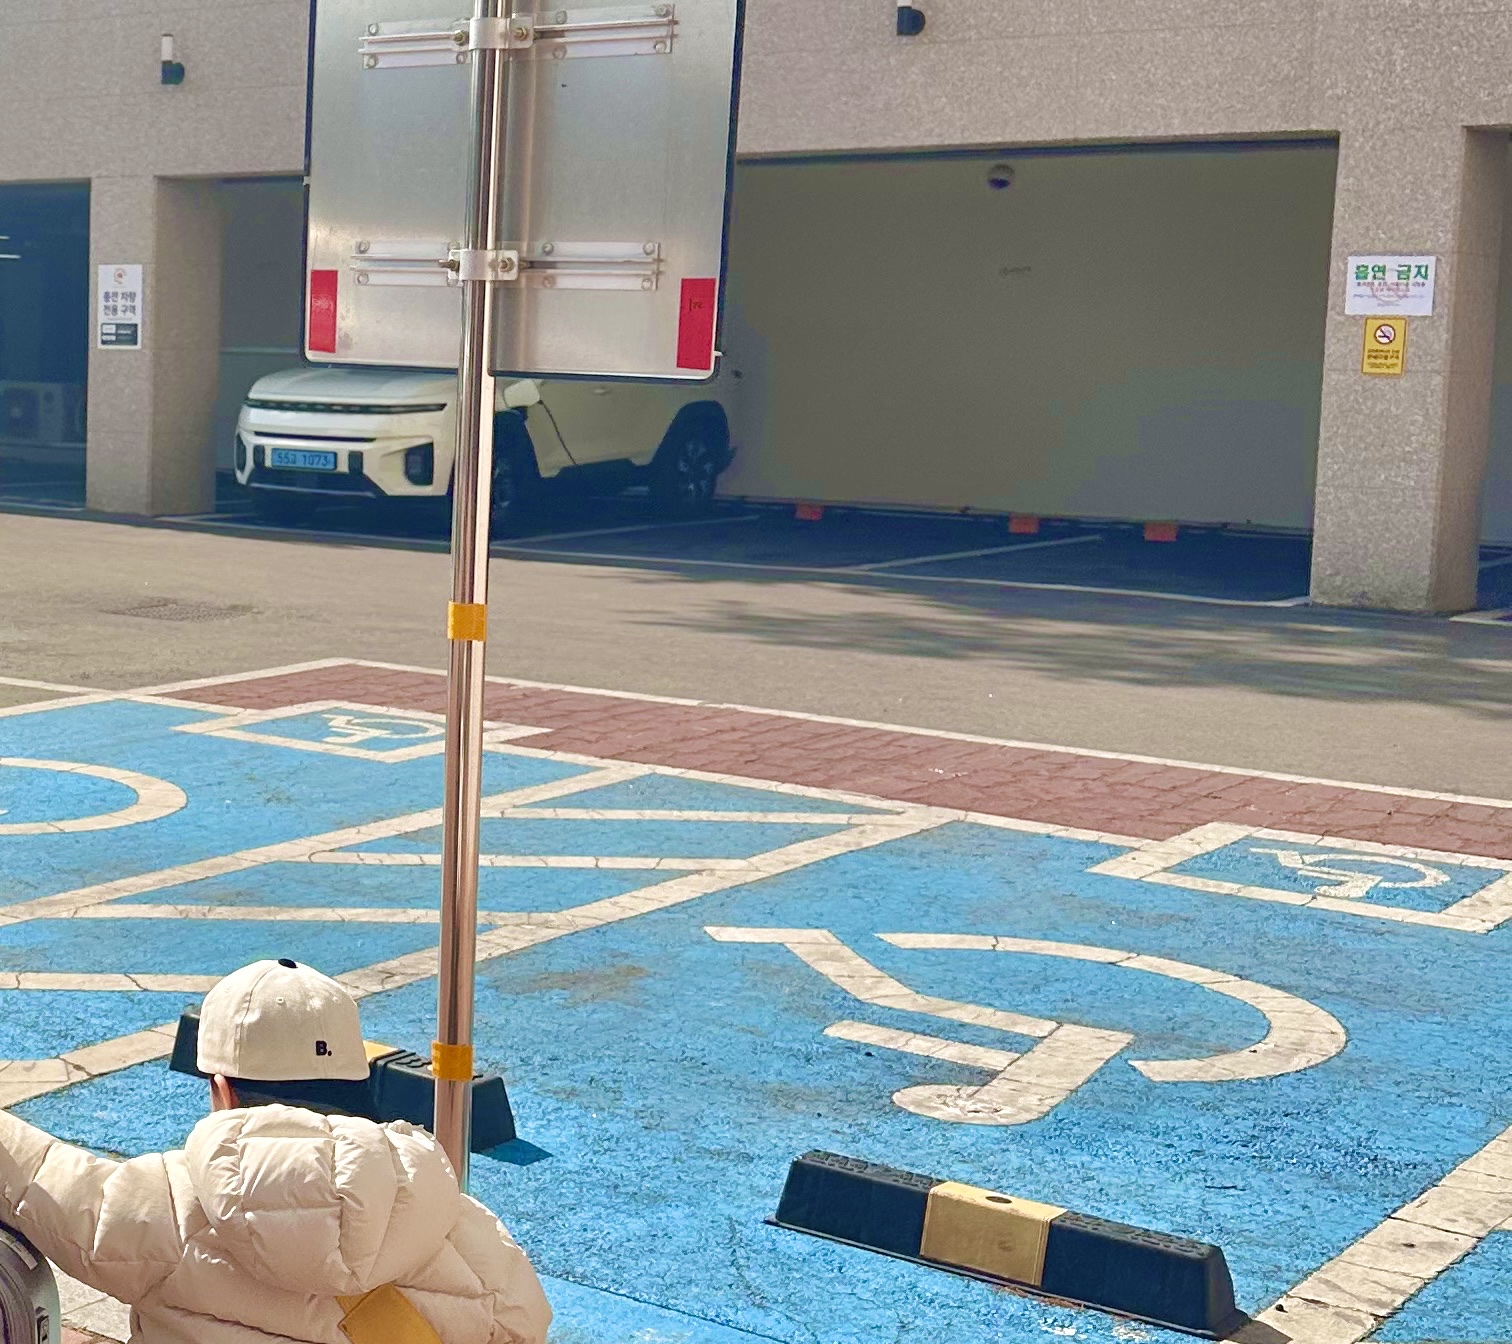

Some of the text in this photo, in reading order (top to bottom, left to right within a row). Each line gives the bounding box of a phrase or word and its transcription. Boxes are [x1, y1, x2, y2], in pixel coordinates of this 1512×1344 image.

[1355, 264, 1429, 280] 흡연 금지
[121, 304, 136, 316] 구역
[314, 1040, 333, 1057] B.
